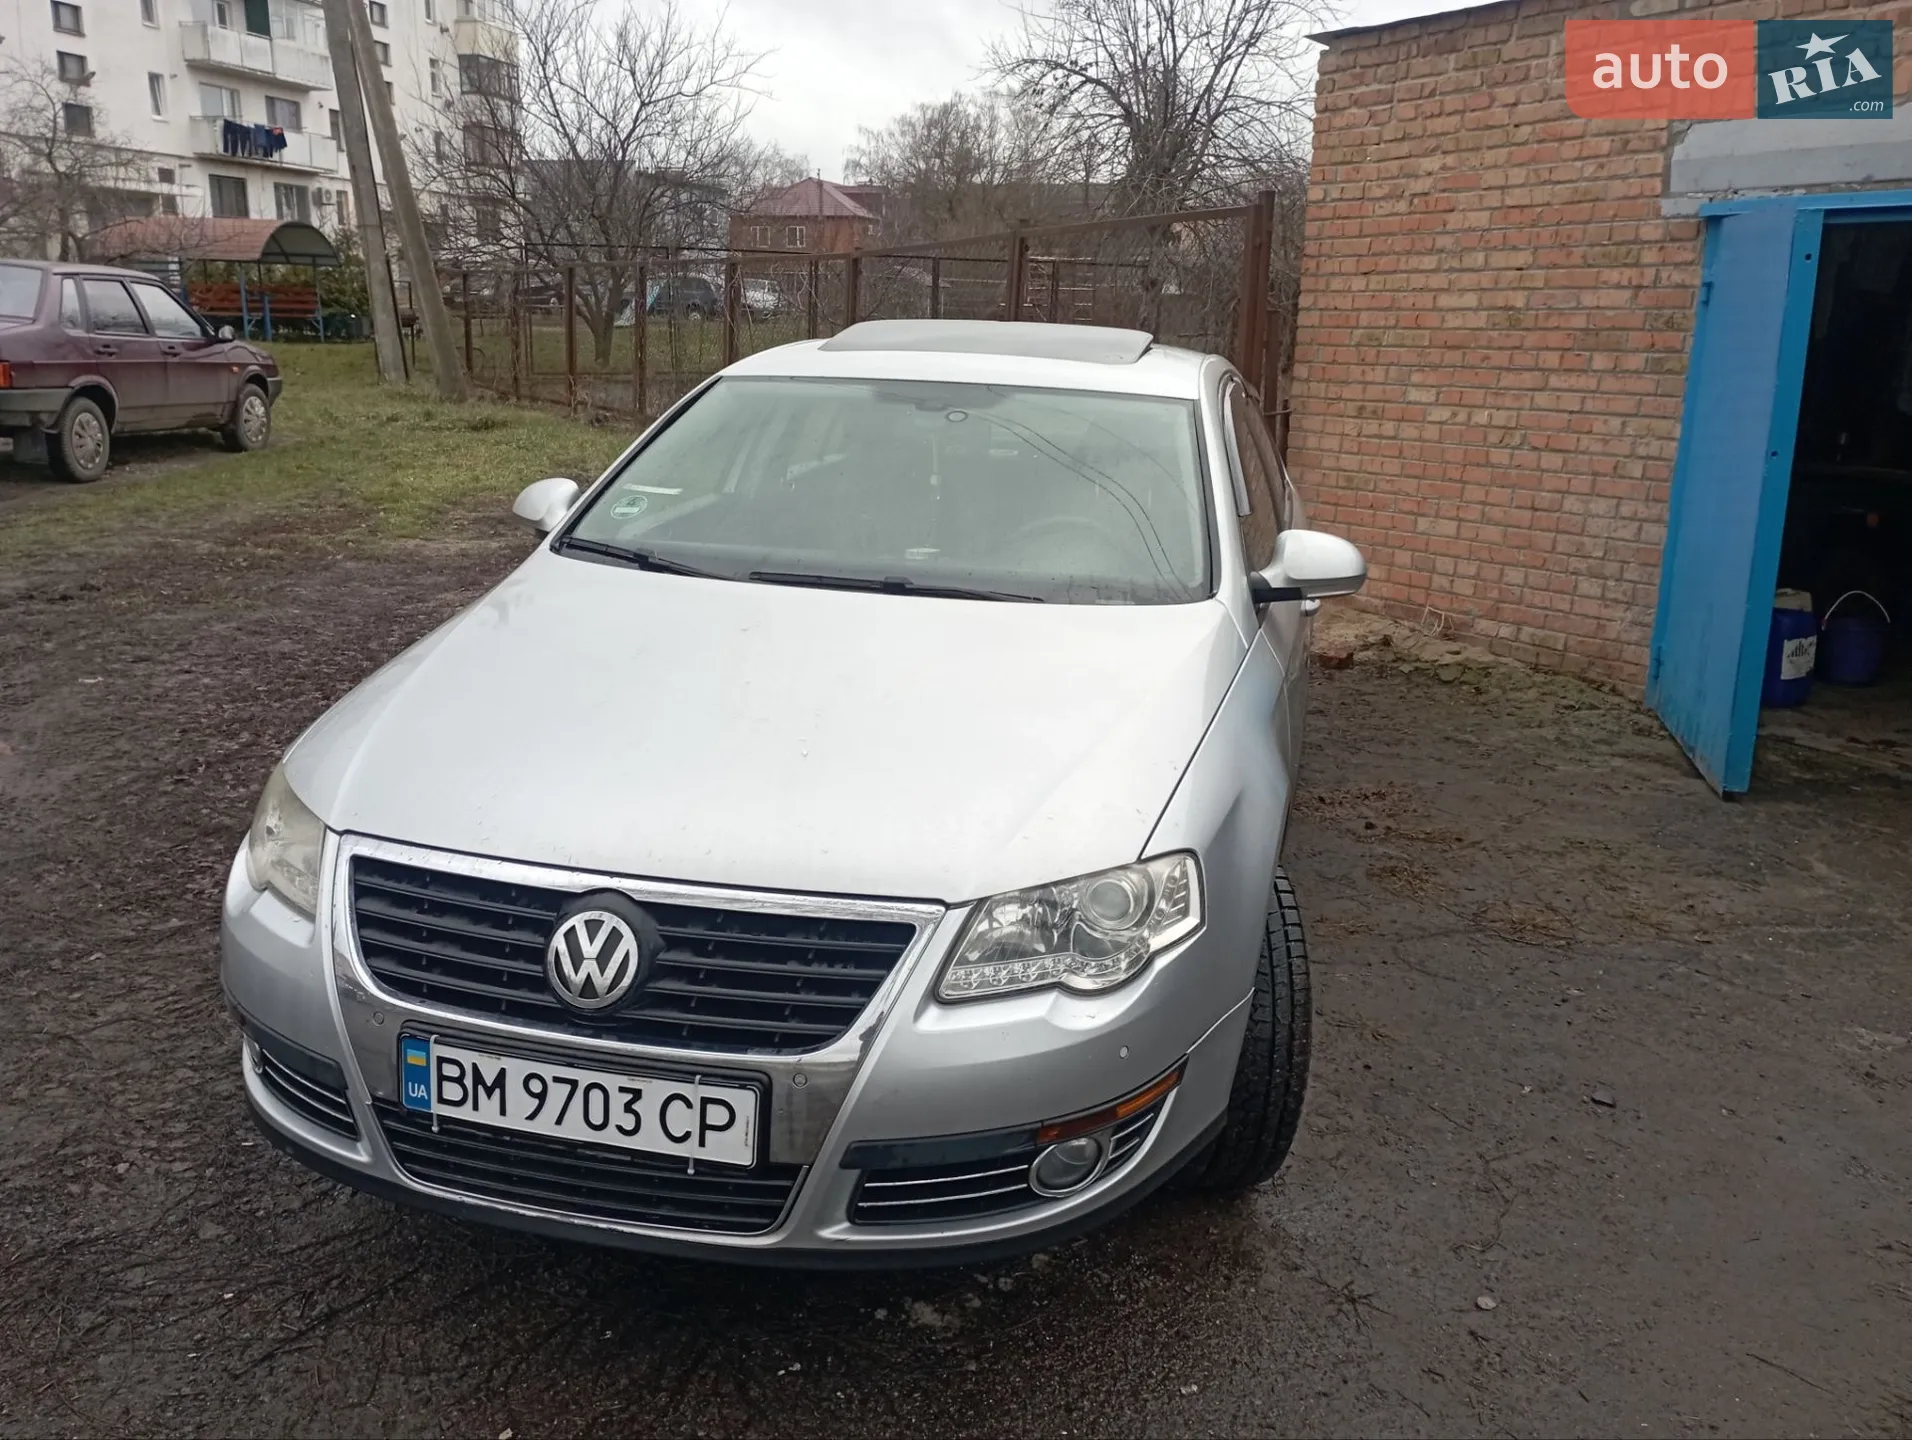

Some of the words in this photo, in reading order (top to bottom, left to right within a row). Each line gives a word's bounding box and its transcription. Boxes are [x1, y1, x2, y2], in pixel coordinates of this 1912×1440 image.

[408, 1081, 428, 1100] UA
[436, 1055, 507, 1117] BM
[522, 1072, 643, 1137] 9703
[659, 1092, 737, 1148] CP
